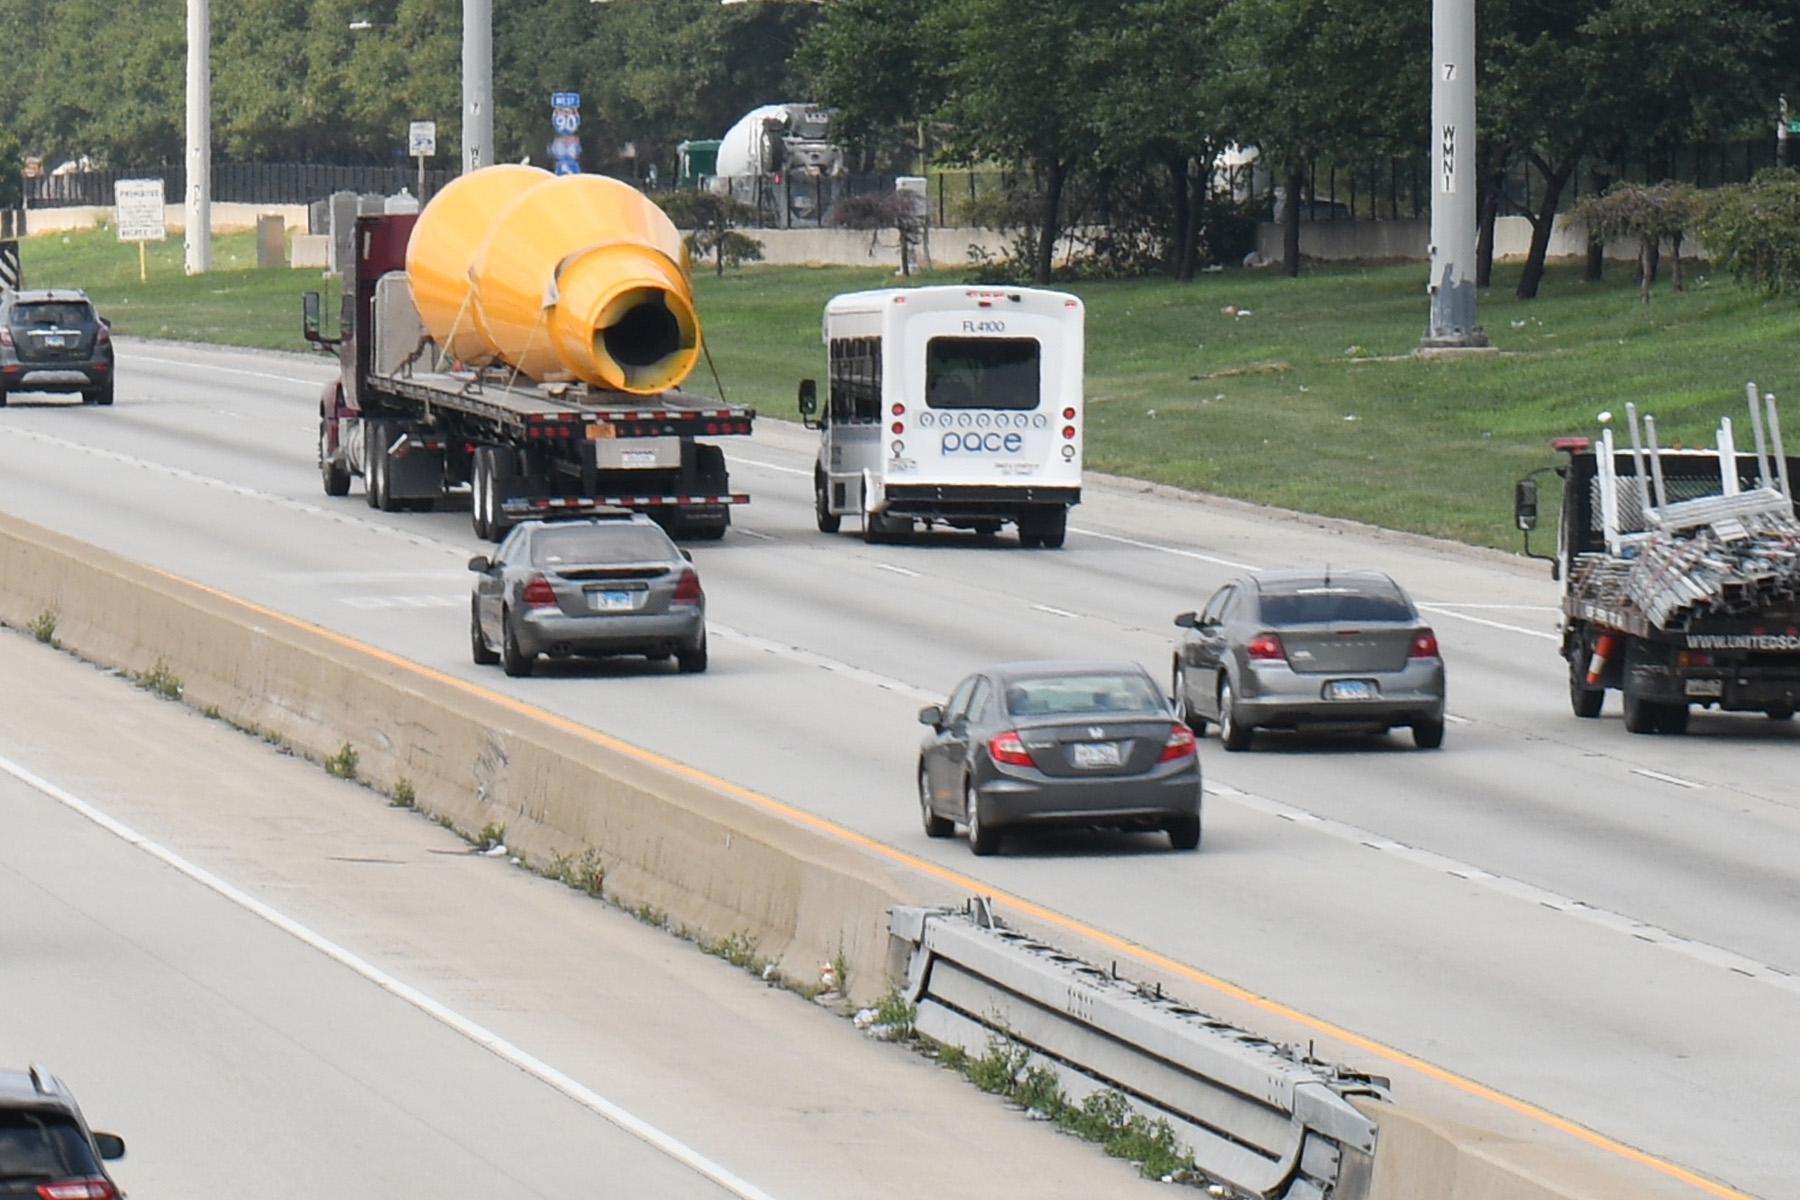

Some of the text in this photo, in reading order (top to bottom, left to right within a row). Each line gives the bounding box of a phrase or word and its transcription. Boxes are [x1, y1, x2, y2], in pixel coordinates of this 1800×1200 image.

[1444, 64, 1455, 80] 7
[556, 115, 576, 131] 90
[941, 431, 1022, 456] pace
[1686, 634, 1800, 650] WWW.UNITEDSC
